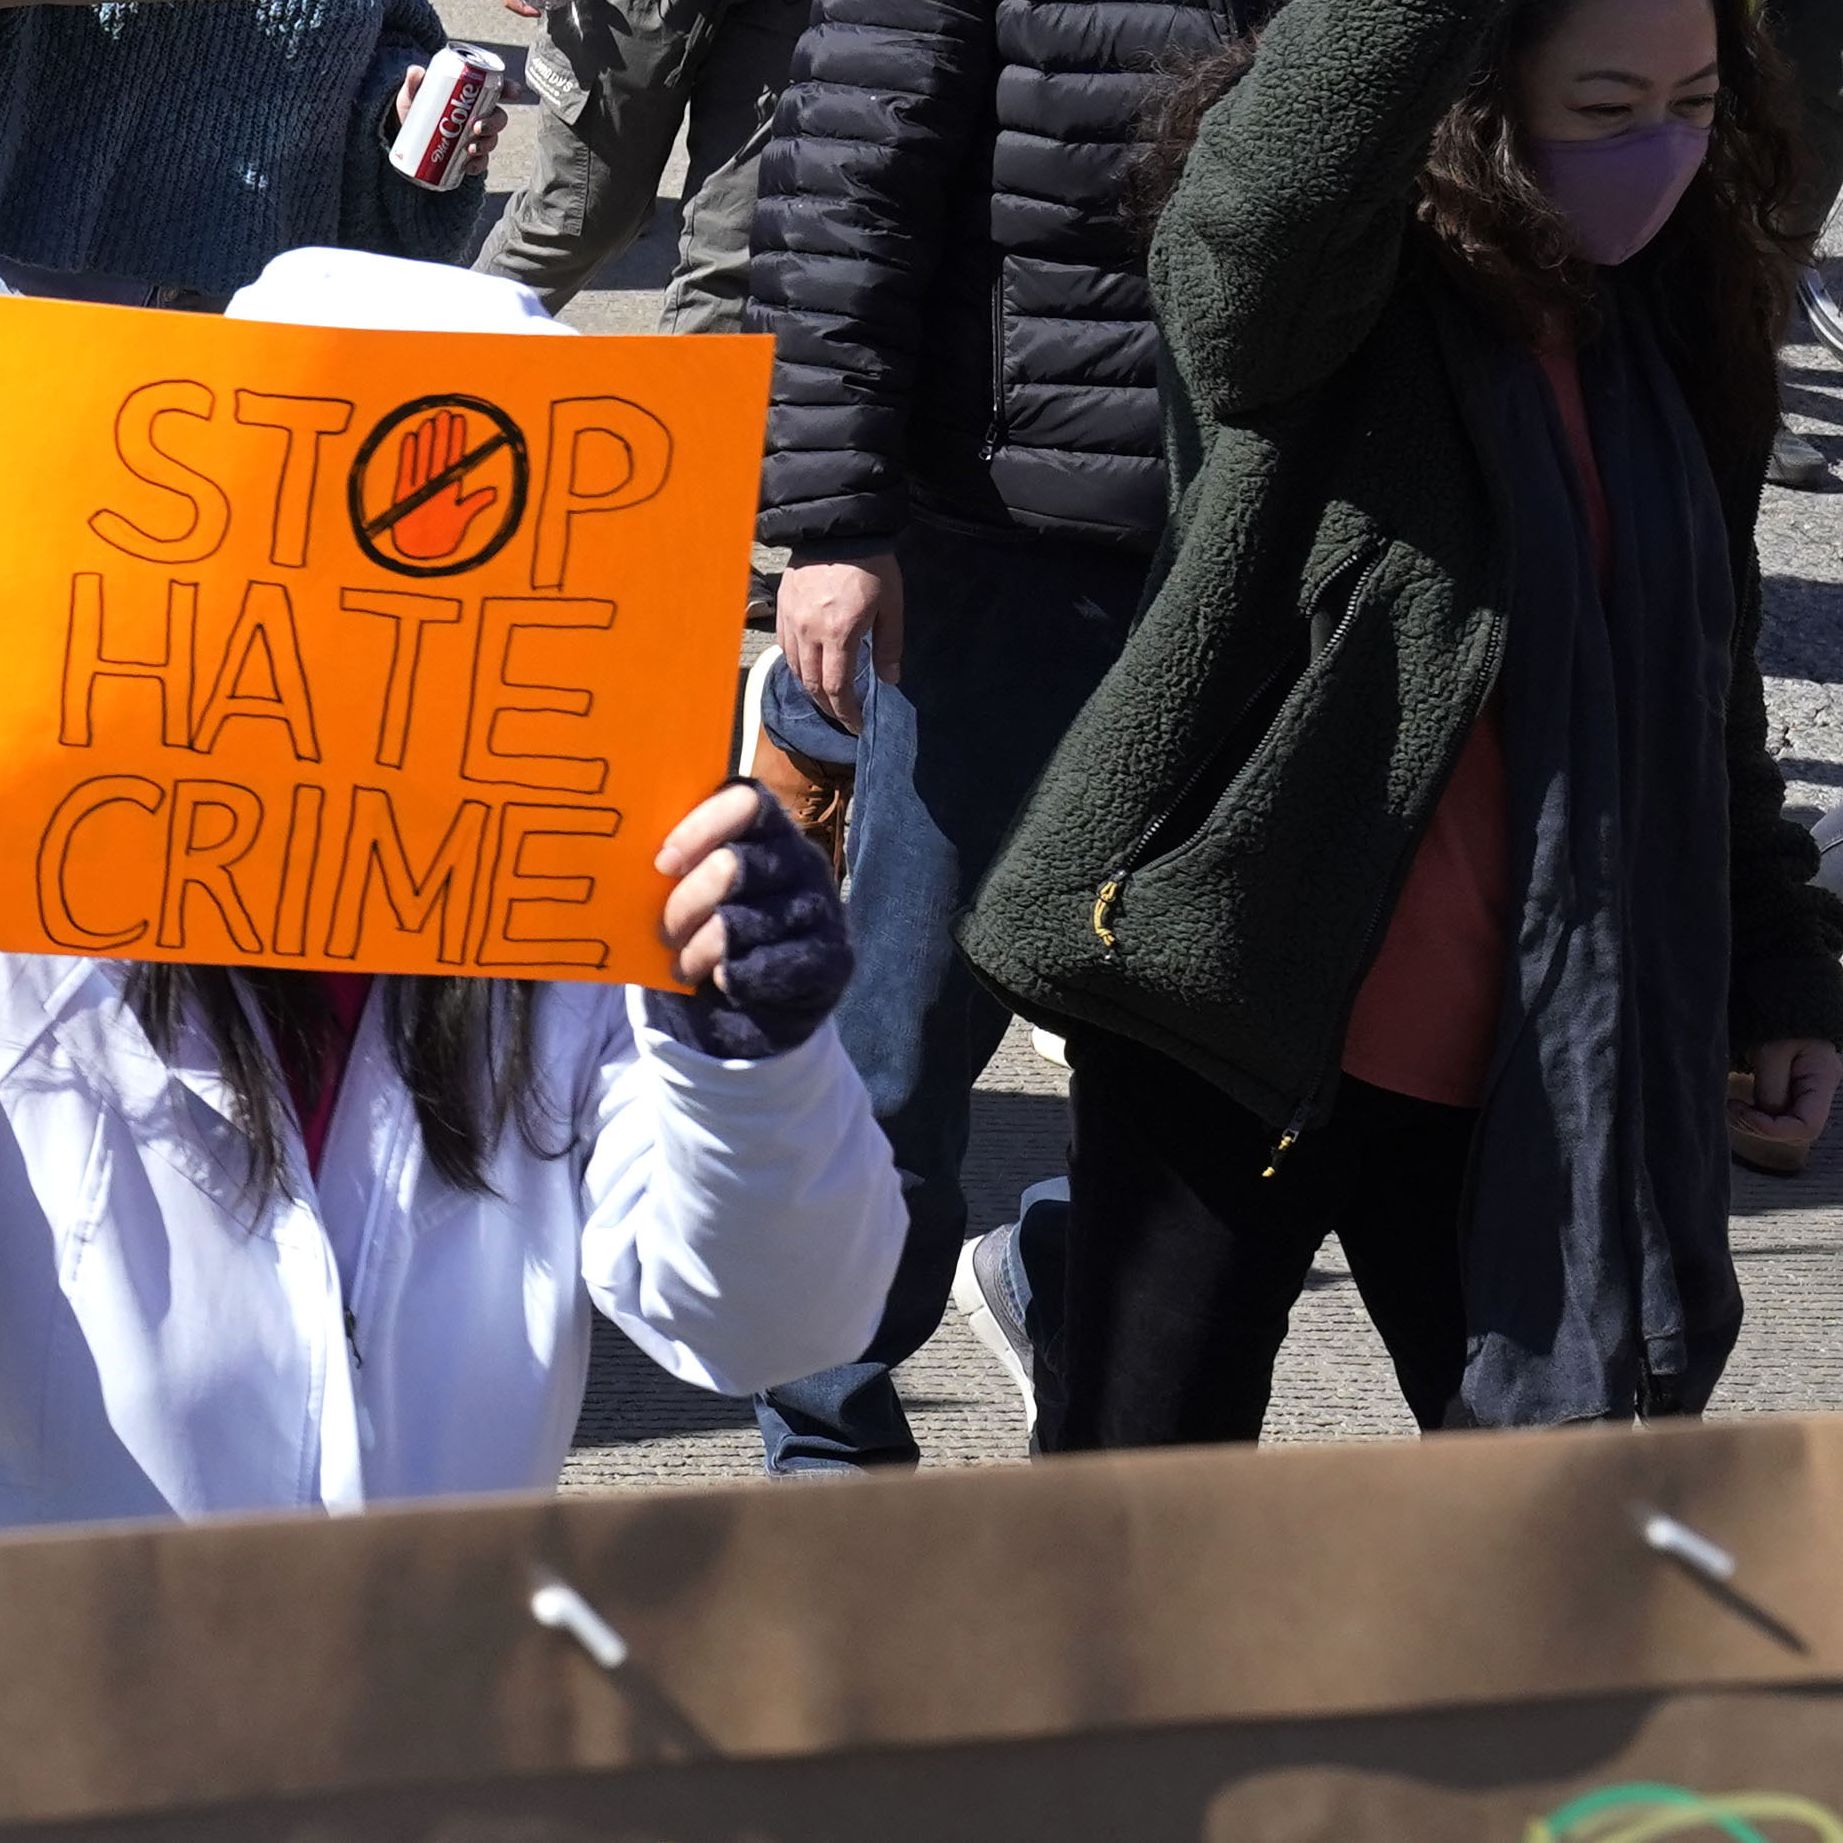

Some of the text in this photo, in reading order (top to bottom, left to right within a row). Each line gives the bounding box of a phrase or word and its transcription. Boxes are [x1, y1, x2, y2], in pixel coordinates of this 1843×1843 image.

[439, 83, 480, 139] Coke
[57, 572, 617, 796] HATE
[36, 771, 622, 969] CRIME
